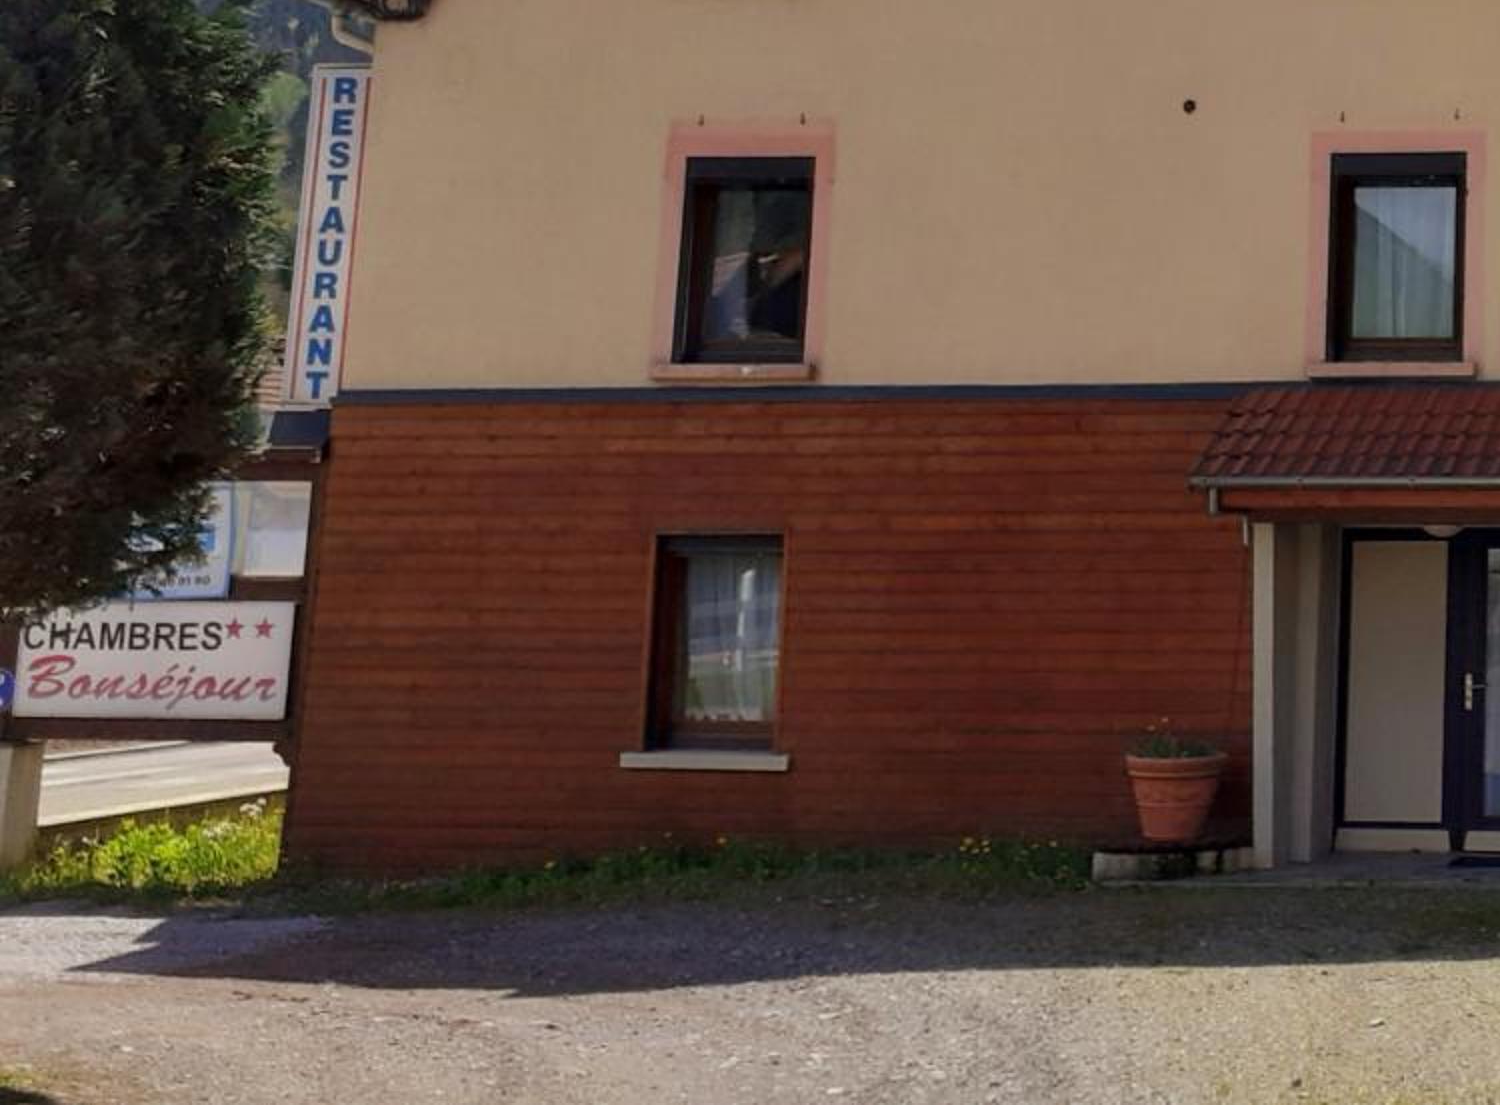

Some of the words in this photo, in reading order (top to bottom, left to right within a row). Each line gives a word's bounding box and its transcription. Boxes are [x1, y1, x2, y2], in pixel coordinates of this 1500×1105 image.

[305, 77, 357, 400] RESTAURANT
[24, 621, 224, 651] CHAMBRES
[27, 654, 278, 710] Bonséjour
